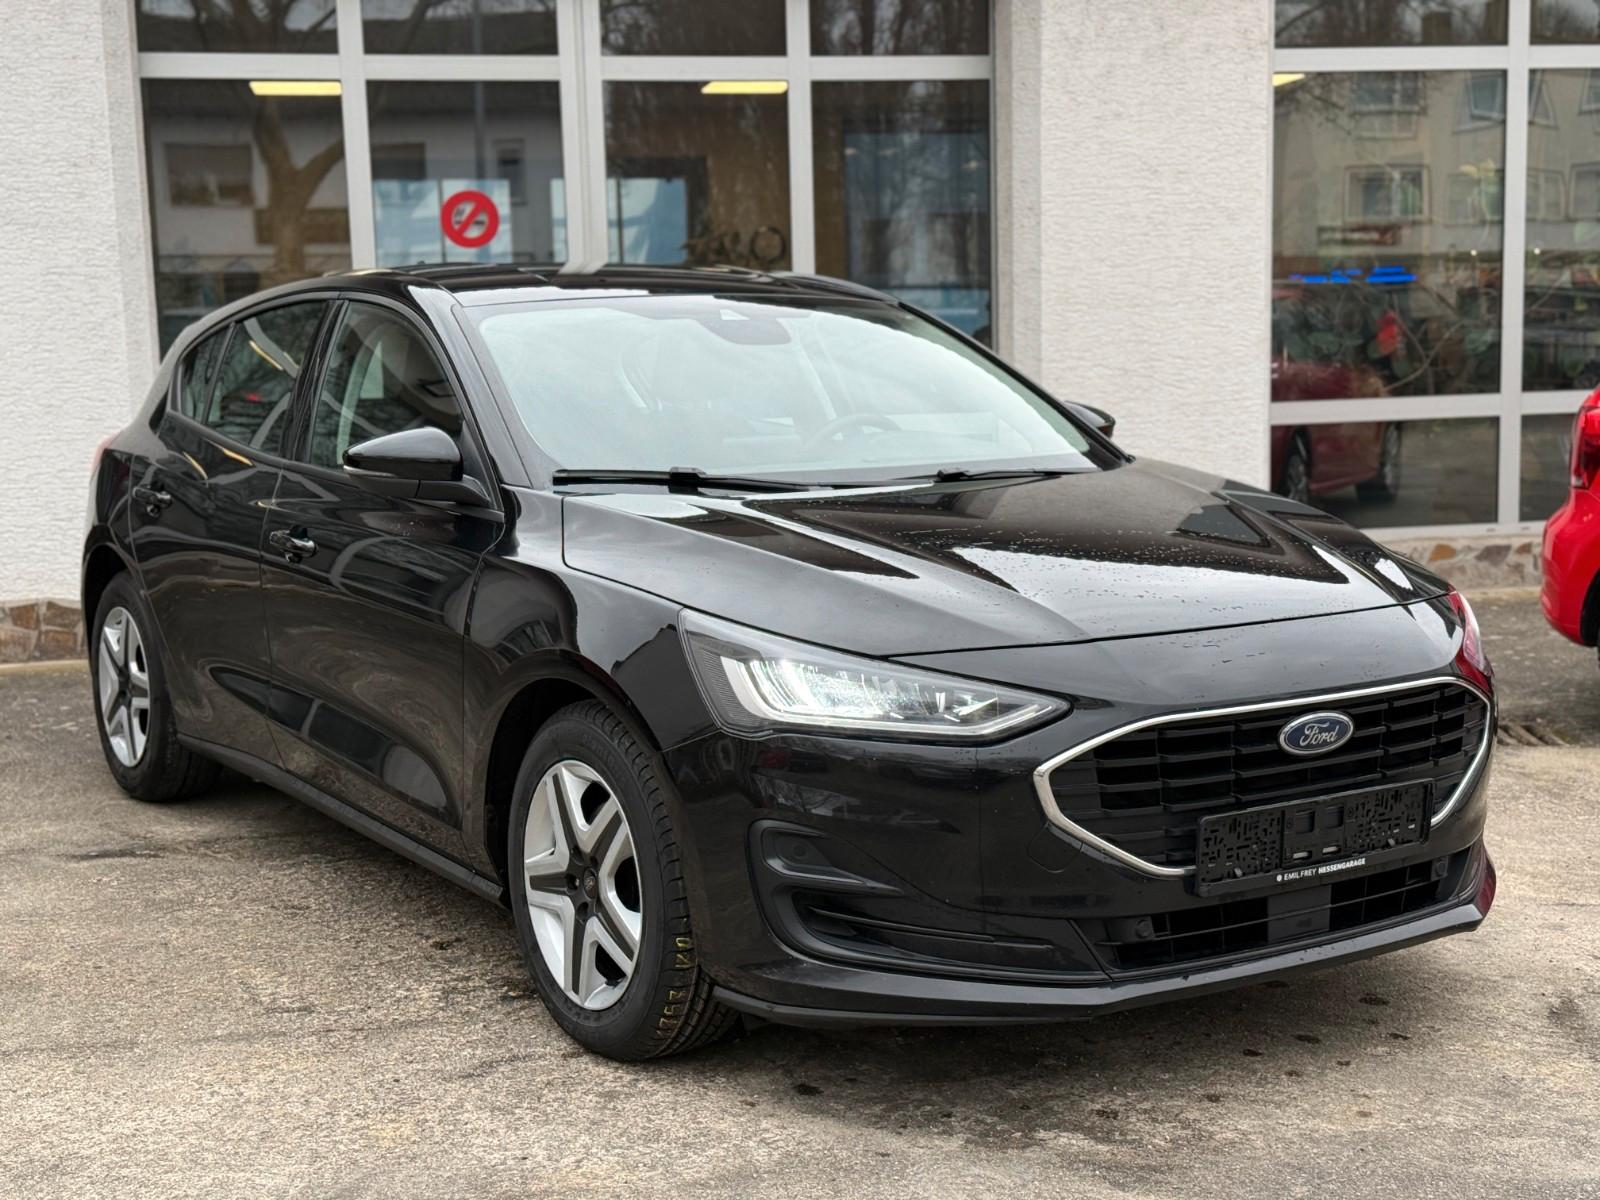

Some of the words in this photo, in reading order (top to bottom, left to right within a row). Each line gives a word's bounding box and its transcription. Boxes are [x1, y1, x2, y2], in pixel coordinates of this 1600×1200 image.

[1299, 721, 1340, 747] Ford
[1284, 872, 1300, 881] EMIL
[1300, 868, 1317, 878] FREY
[1318, 857, 1366, 874] HESSENGARAGE
